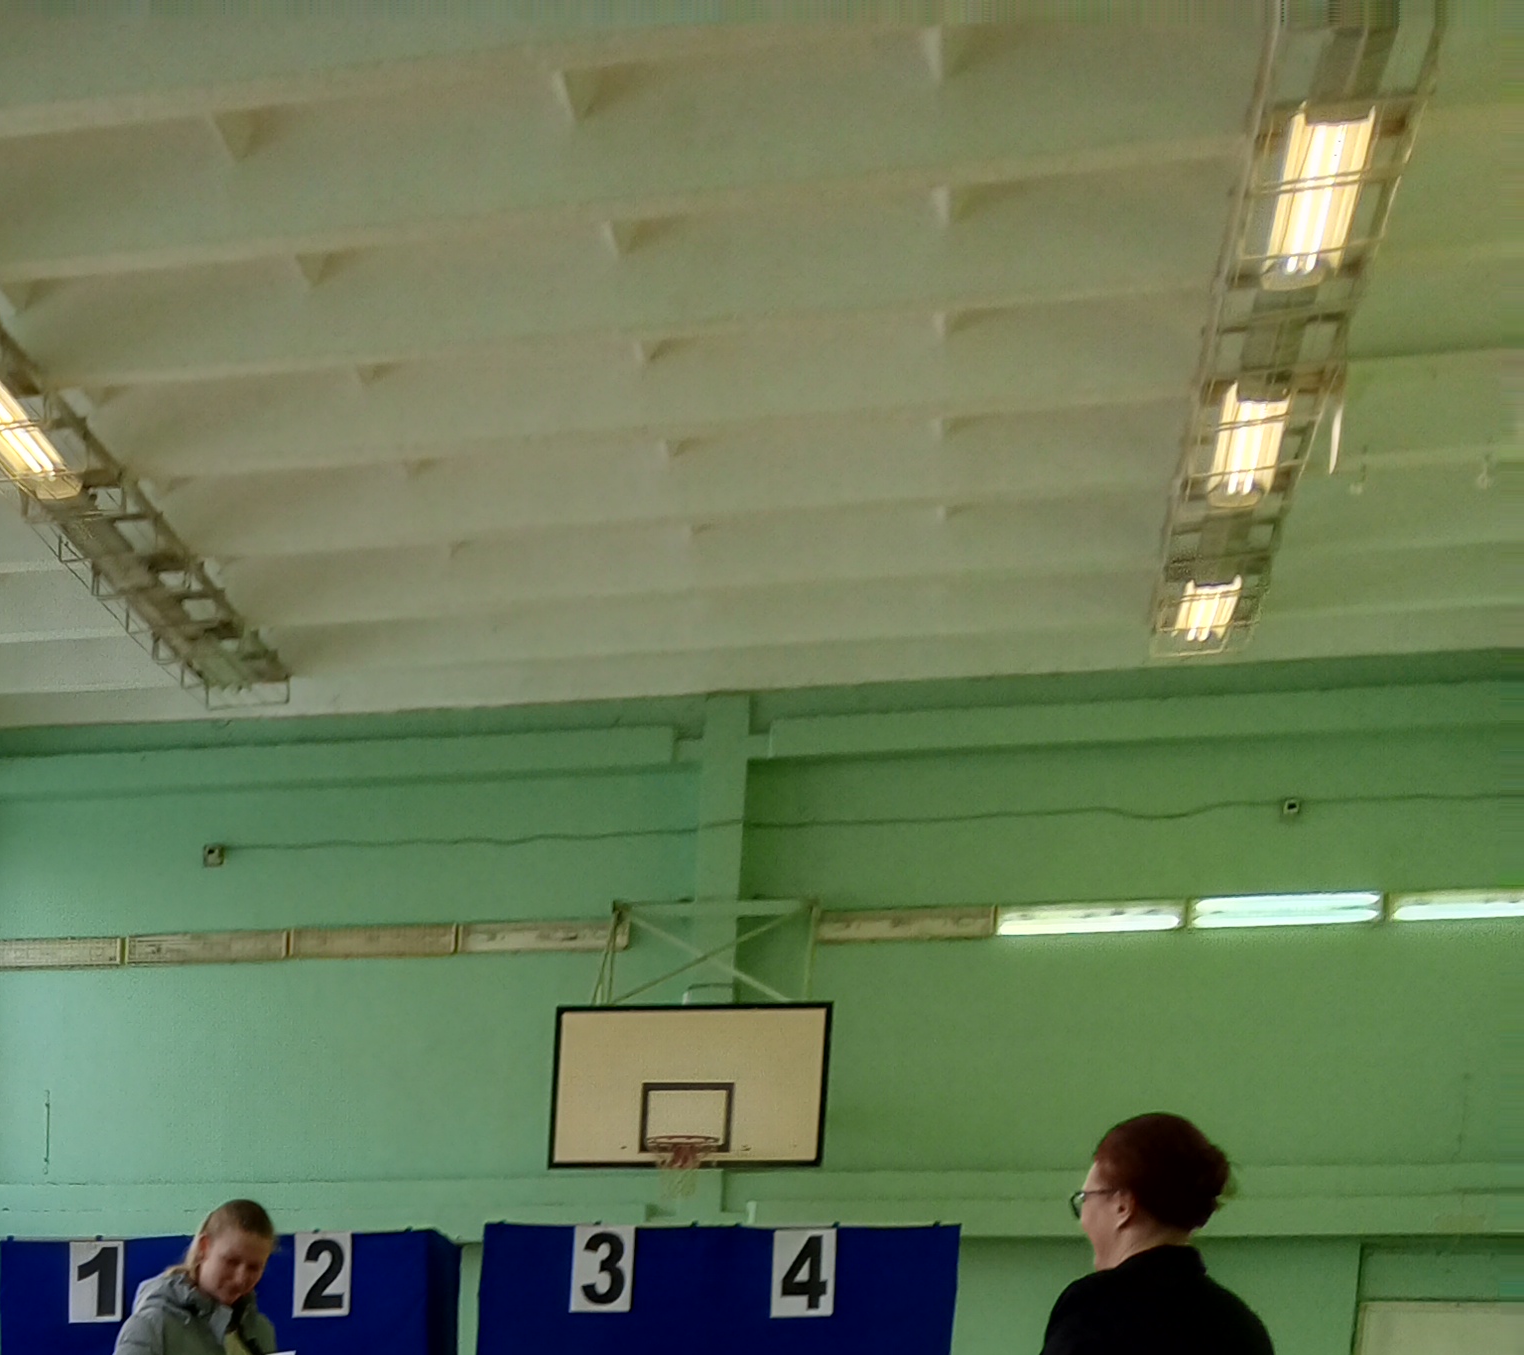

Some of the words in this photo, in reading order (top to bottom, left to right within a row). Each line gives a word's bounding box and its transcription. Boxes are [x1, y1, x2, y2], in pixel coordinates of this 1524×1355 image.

[77, 1246, 118, 1317] 1
[302, 1239, 345, 1310] 2
[581, 1232, 625, 1304] 3
[781, 1235, 828, 1311] 4
